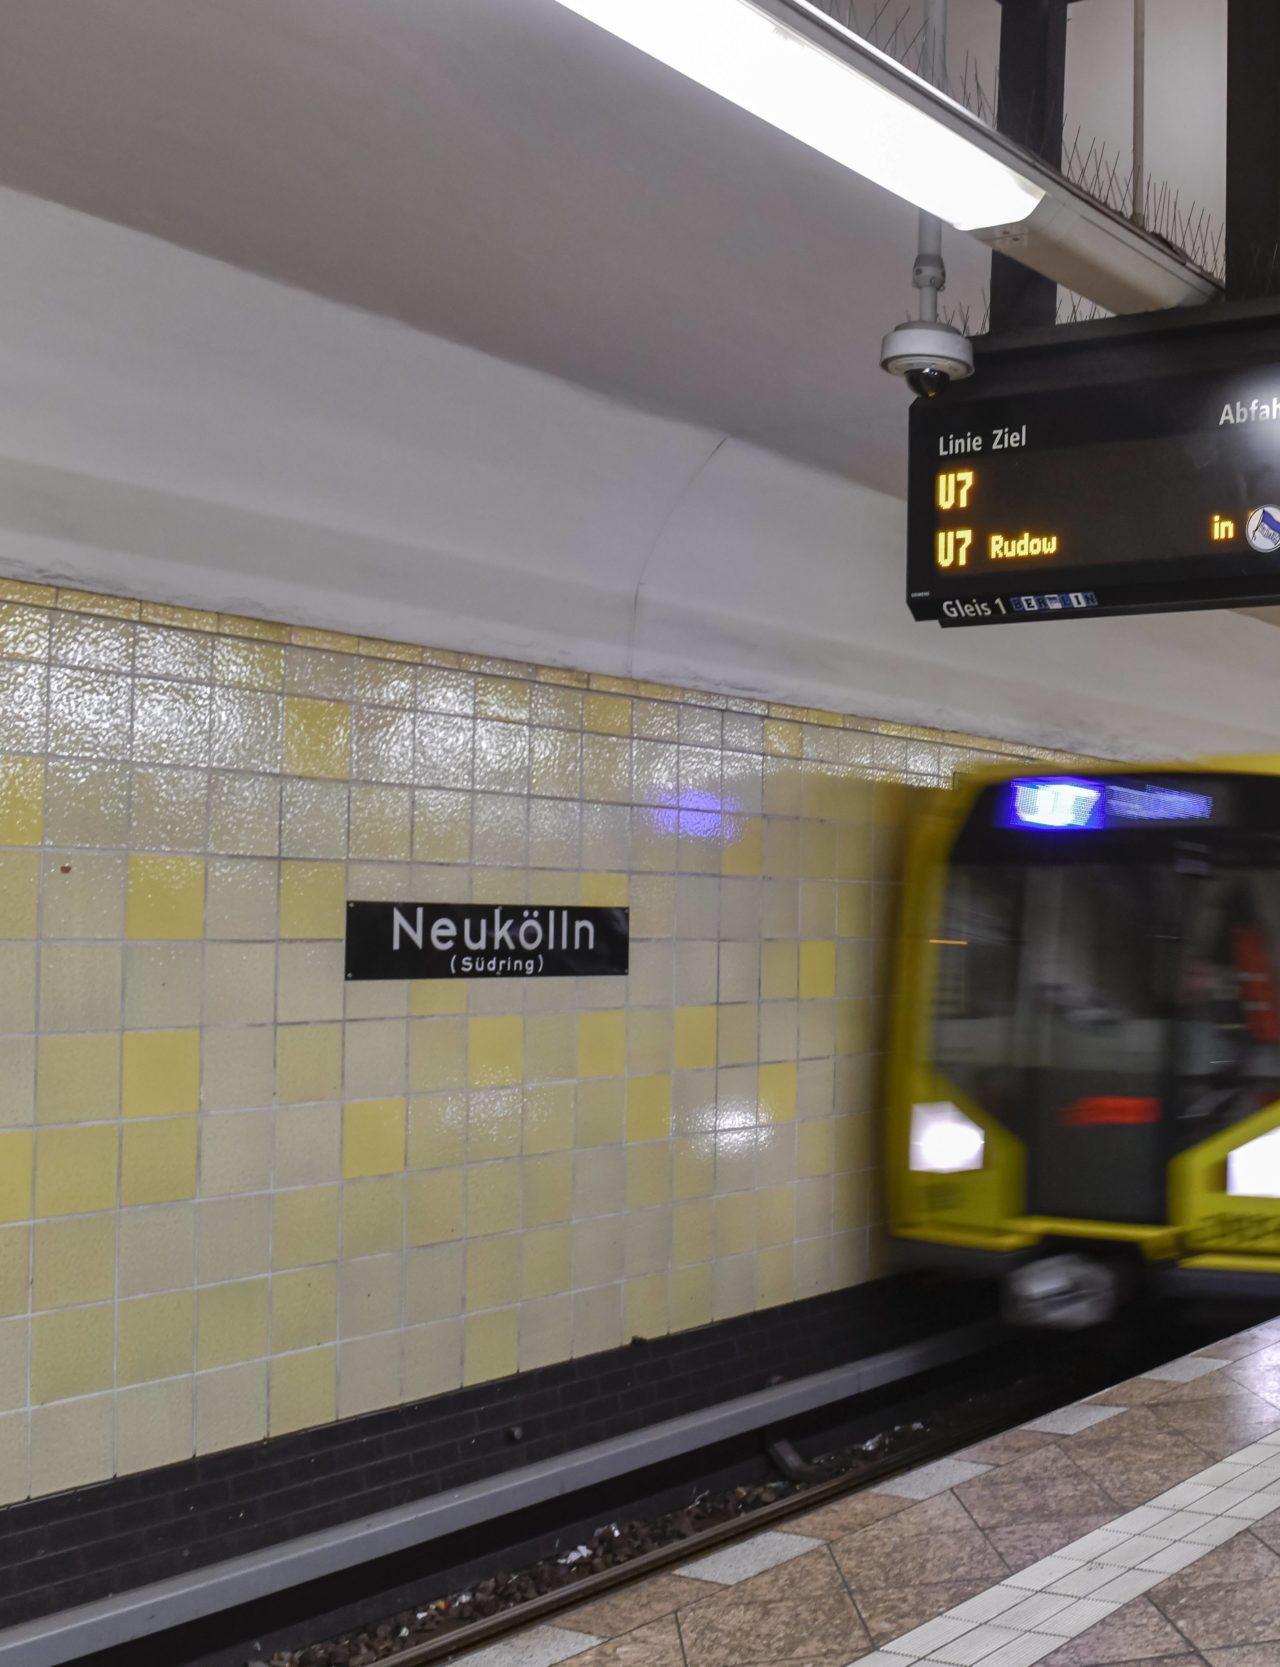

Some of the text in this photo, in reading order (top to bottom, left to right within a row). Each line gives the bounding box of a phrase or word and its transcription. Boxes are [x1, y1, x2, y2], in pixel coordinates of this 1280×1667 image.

[939, 431, 983, 457] Linie
[992, 424, 1027, 450] Ziel
[938, 471, 974, 510] U7
[937, 529, 972, 568] U7
[990, 532, 1058, 560] Rudow
[1213, 514, 1235, 540] in
[942, 597, 1007, 618] Gleis 1
[392, 906, 595, 951] Neukölln
[450, 954, 544, 975] (Südring)
